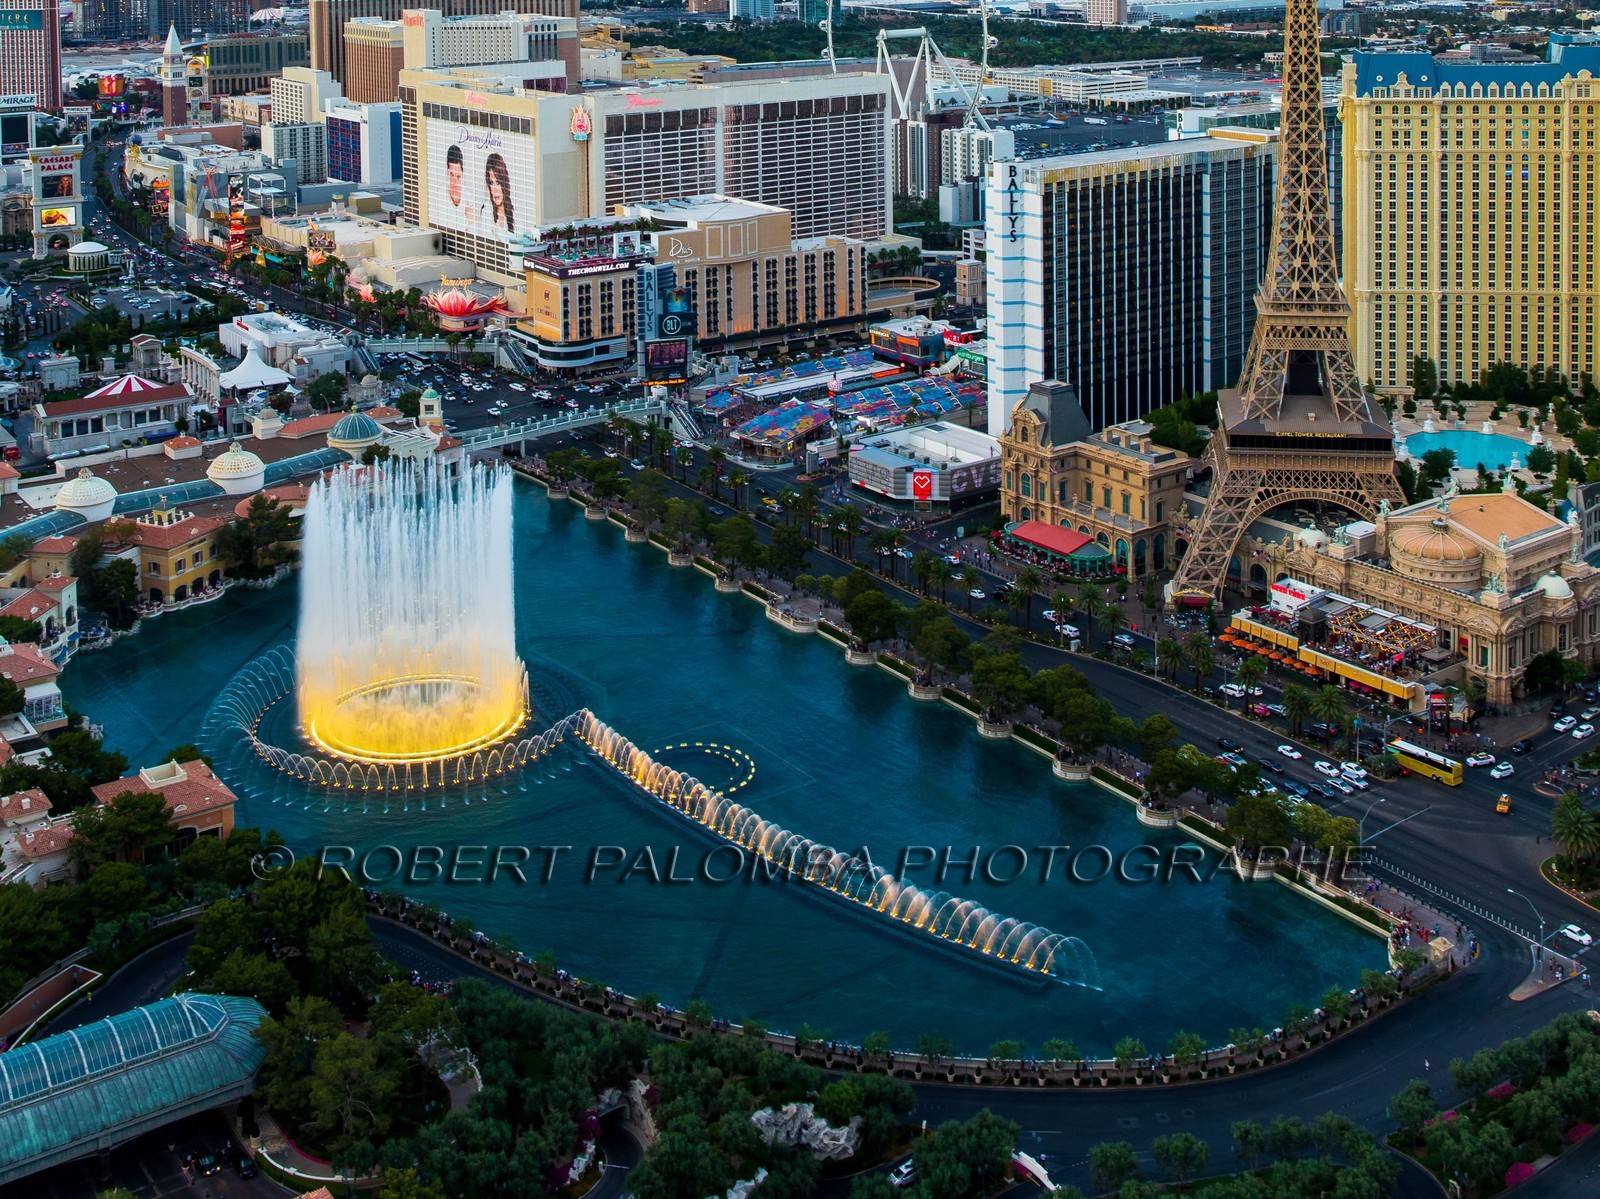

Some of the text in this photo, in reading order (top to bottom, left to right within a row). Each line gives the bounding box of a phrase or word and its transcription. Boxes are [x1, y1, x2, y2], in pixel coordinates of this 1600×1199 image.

[39, 156, 74, 164] CAESARS
[41, 163, 73, 171] PALACE
[1008, 165, 1018, 242] BALLYS
[568, 262, 629, 276] THECROMWELL.COM
[645, 272, 653, 331] BALLYS
[666, 319, 678, 330] BLT
[952, 461, 1001, 492] CVS
